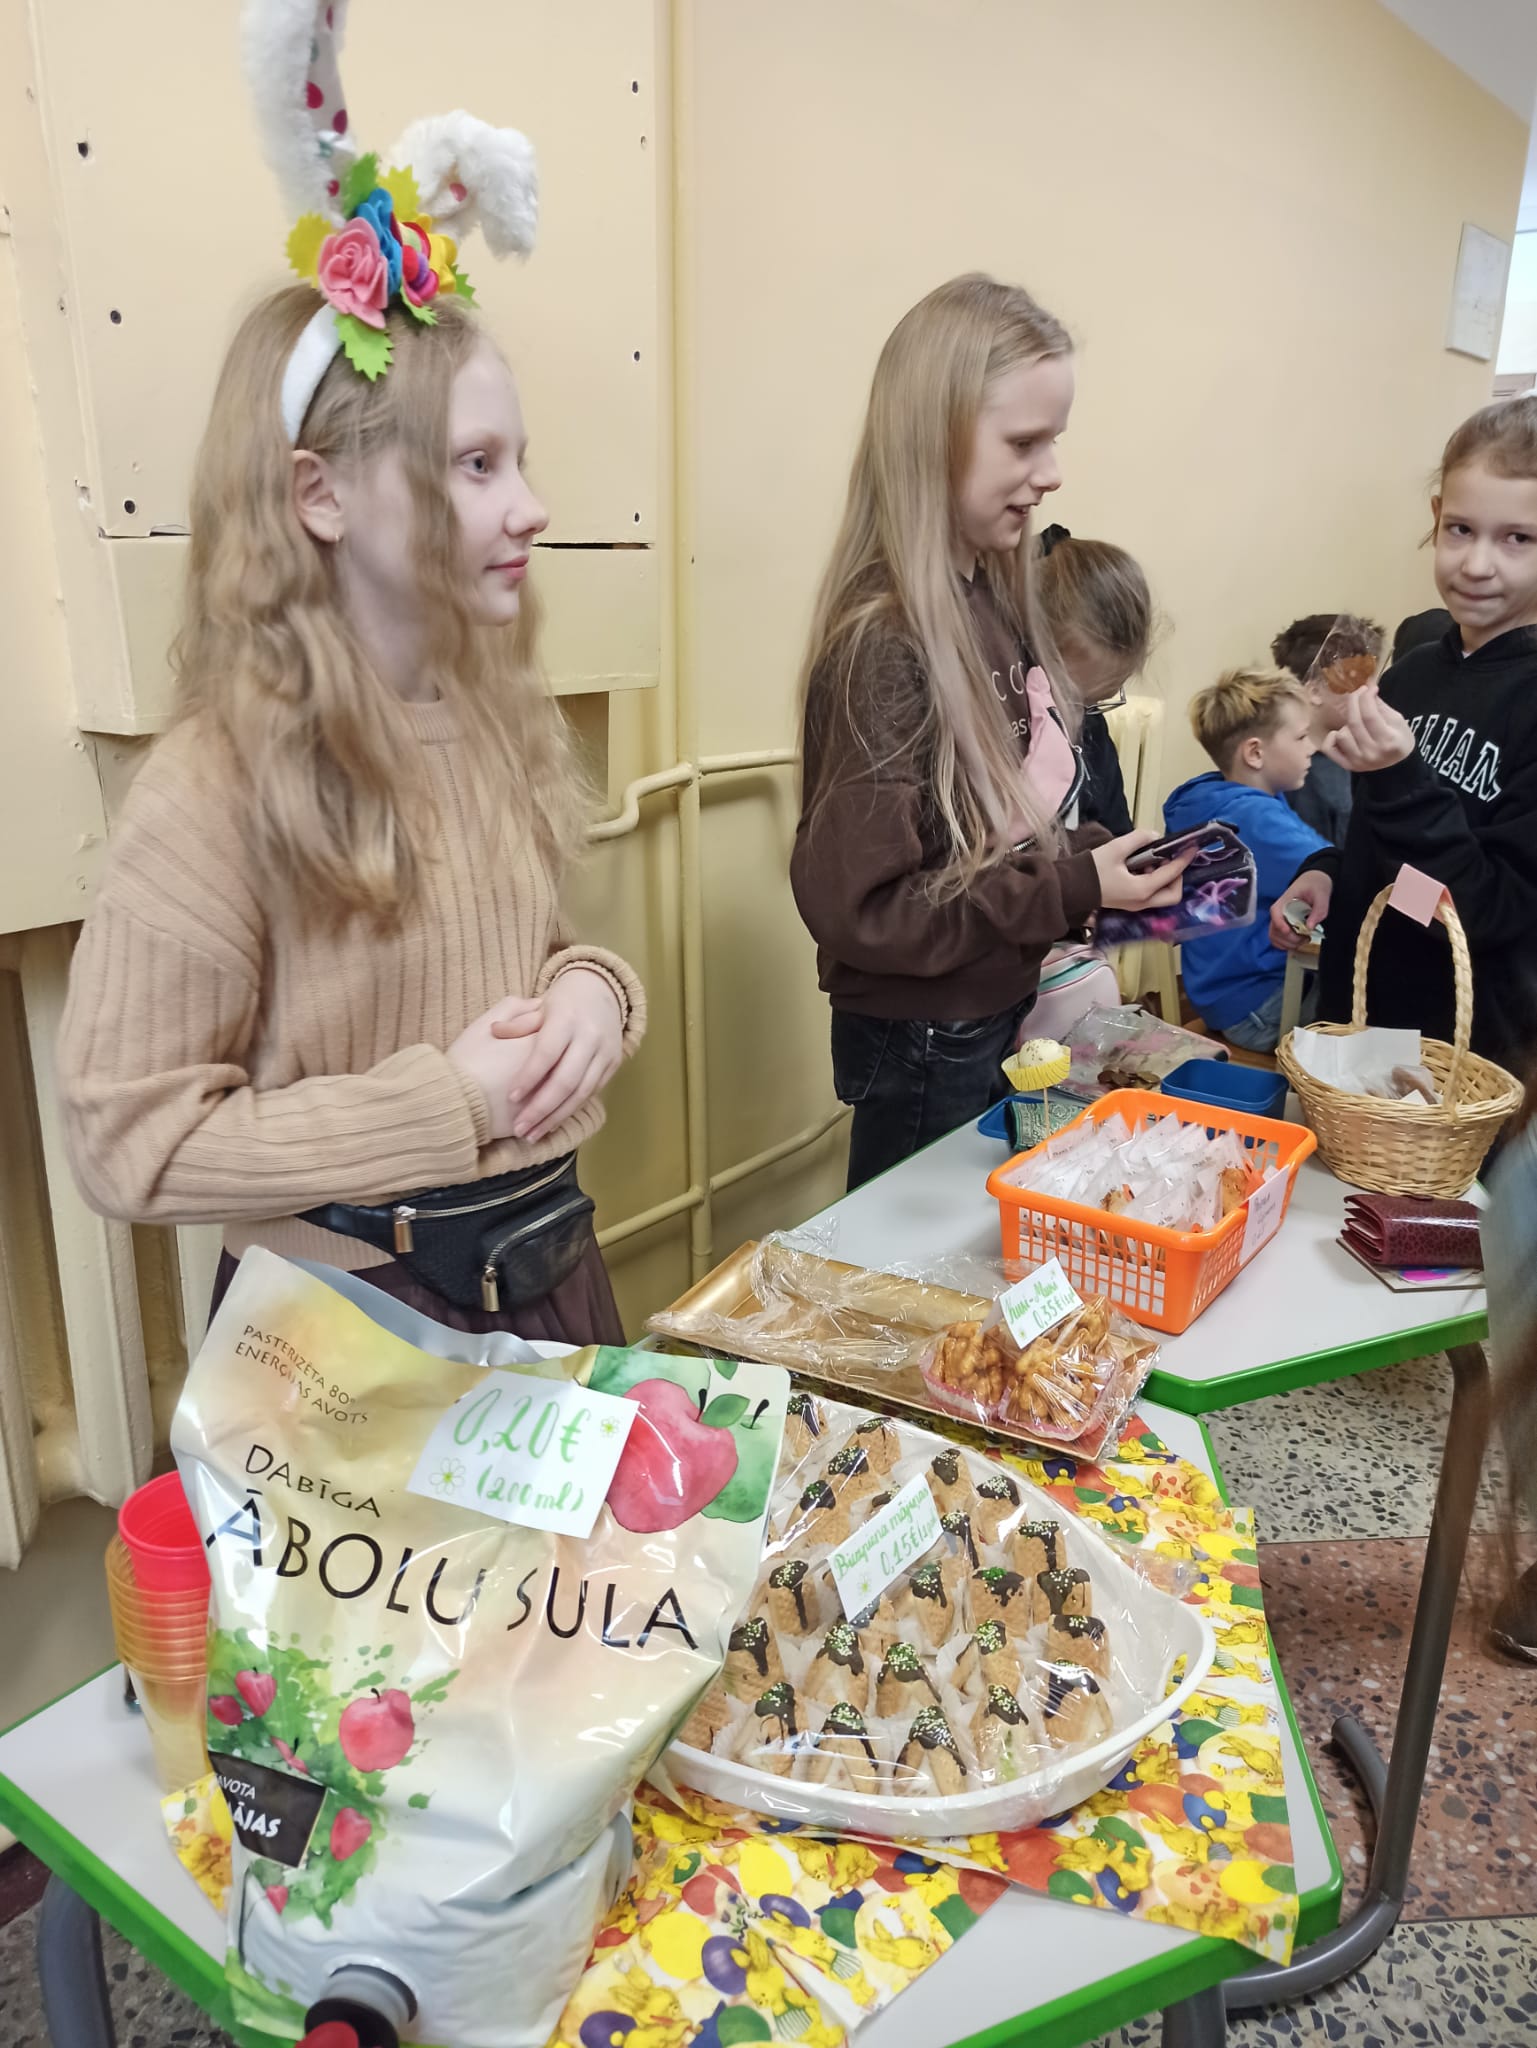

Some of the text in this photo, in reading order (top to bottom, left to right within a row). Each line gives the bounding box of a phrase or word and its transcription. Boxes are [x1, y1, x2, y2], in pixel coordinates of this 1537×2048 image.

[243, 1325, 325, 1388] PASTERIZĒTA
[312, 1398, 368, 1425] AVOTS
[453, 1387, 592, 1463] 0,20€
[245, 1444, 381, 1518] DABĪGA
[205, 1488, 700, 1650] ĀBOLU SULA
[228, 1801, 282, 1838] ĀJAS
